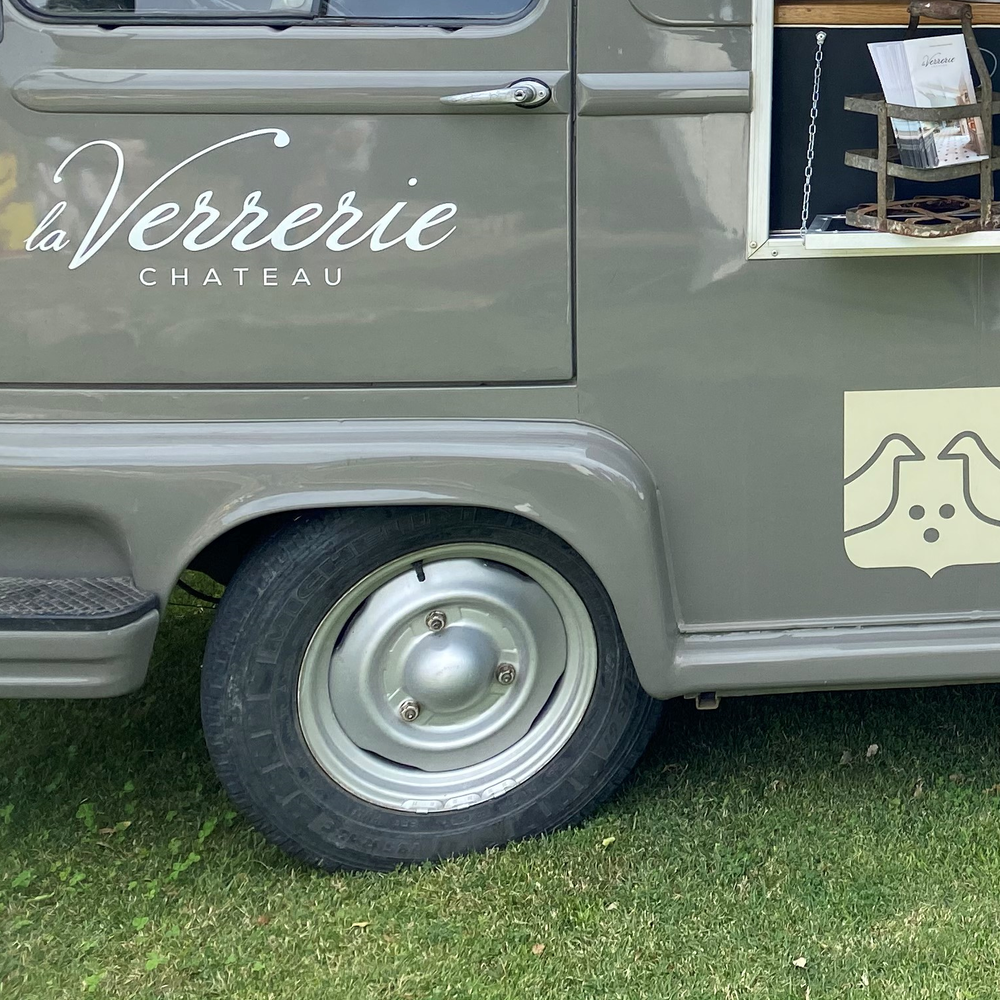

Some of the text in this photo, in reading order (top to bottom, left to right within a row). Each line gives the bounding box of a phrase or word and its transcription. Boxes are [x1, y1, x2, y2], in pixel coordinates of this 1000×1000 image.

[23, 127, 458, 270] la Verrerie
[139, 267, 342, 286] CHATEAU
